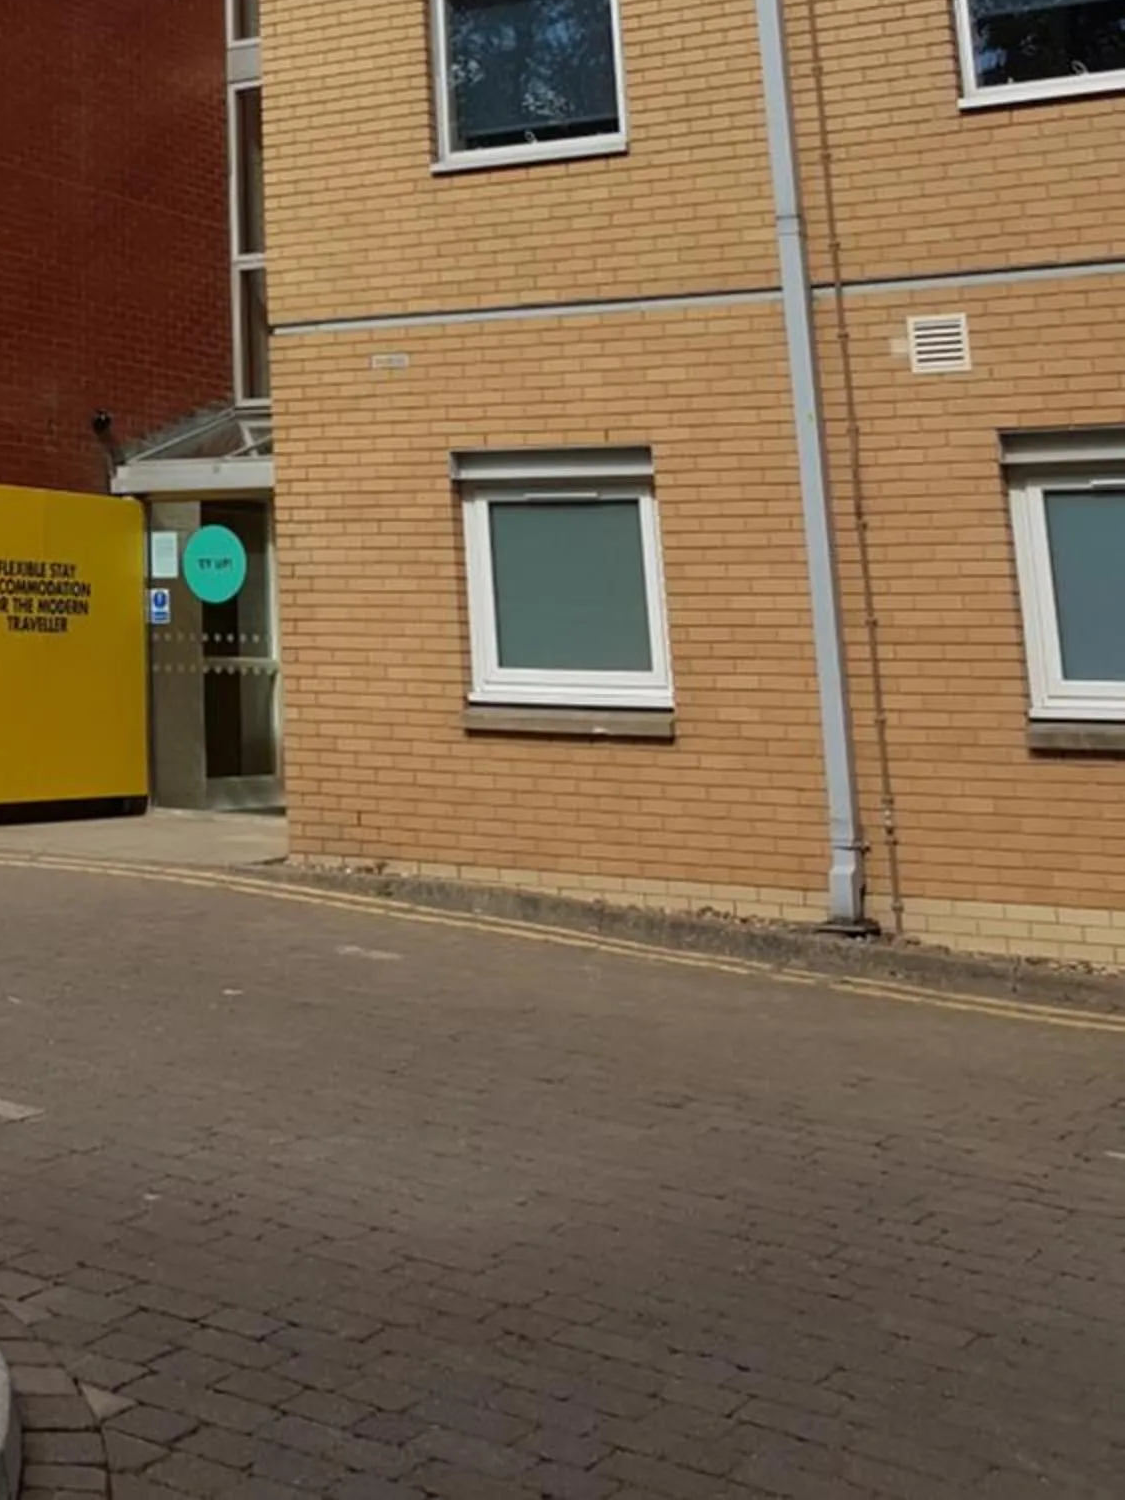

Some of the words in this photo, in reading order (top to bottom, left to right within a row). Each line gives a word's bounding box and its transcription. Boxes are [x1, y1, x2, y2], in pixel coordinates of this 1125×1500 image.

[50, 563, 76, 577] STAY
[13, 598, 33, 613] THE
[38, 599, 89, 615] MODERN
[7, 615, 68, 633] TRAVELLER
